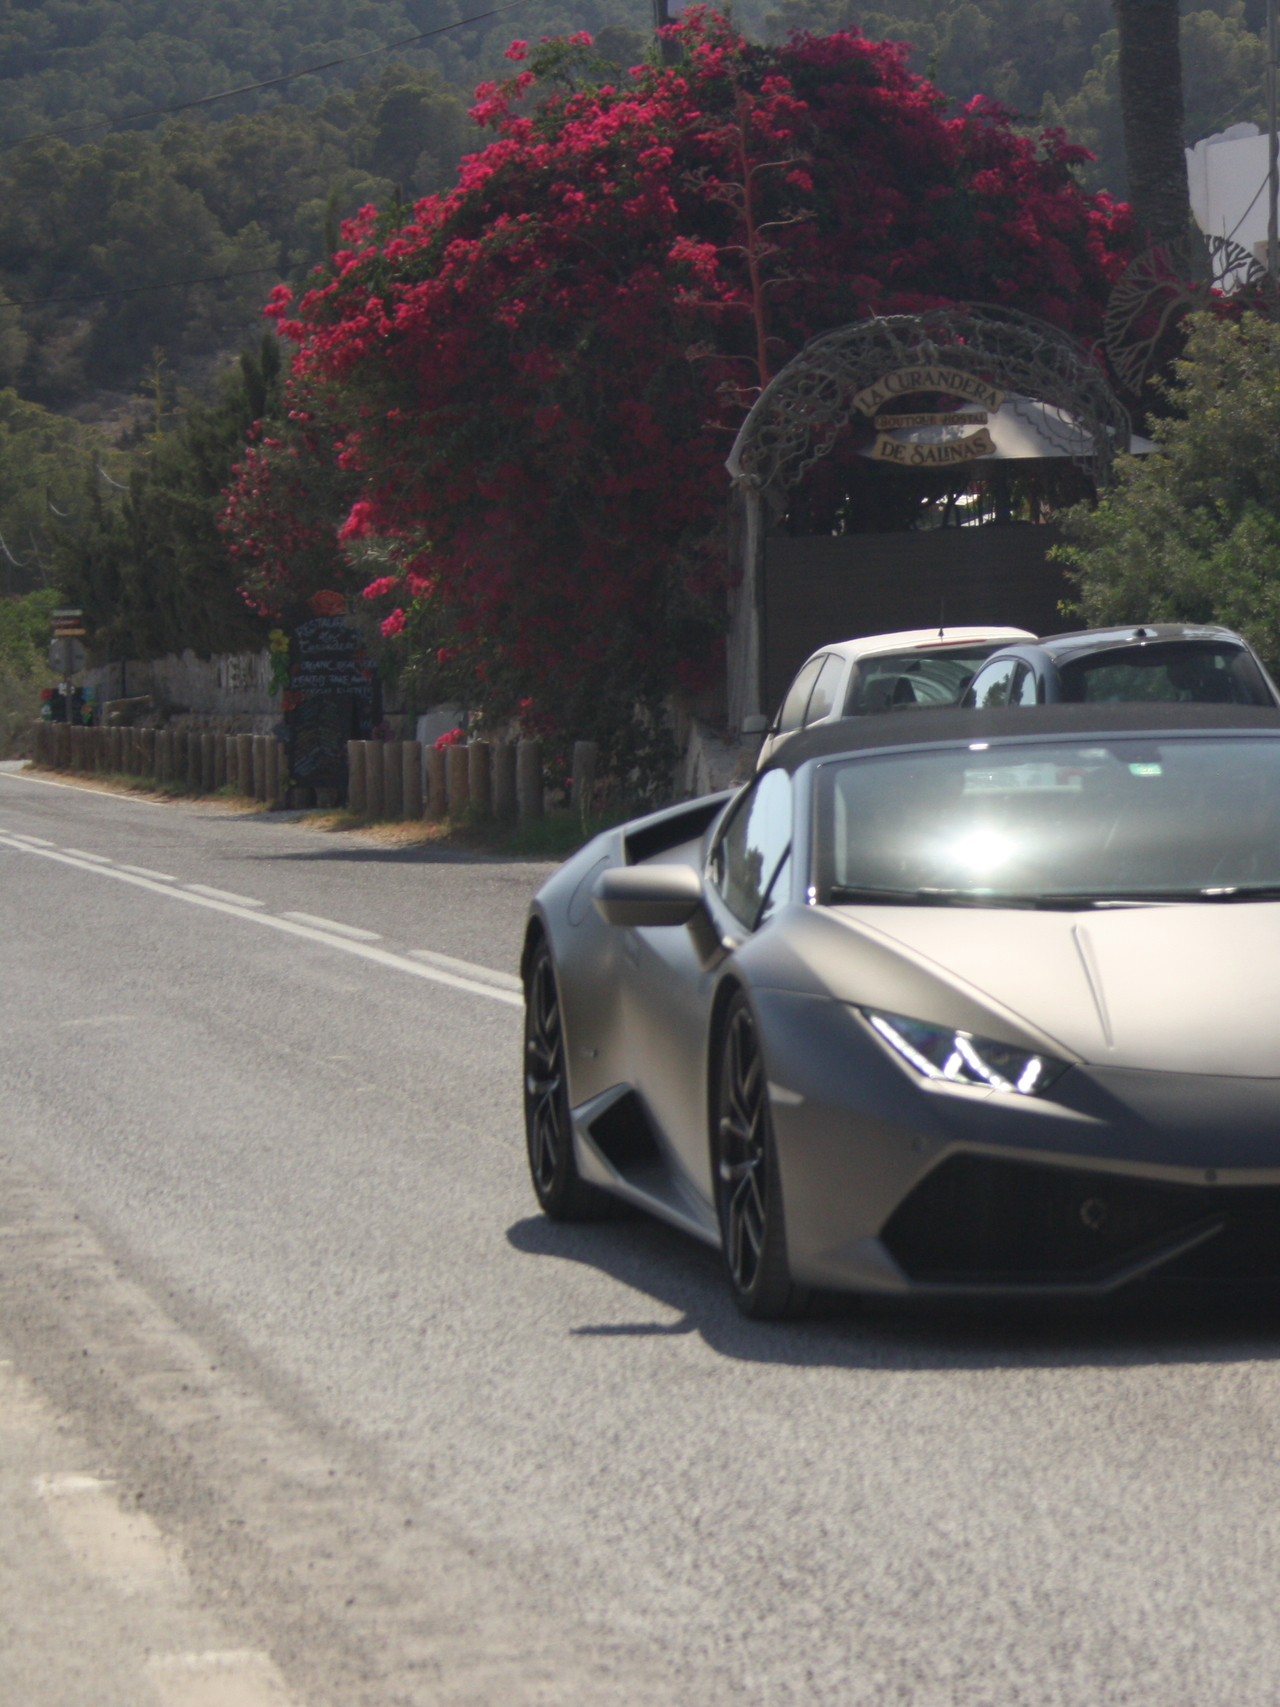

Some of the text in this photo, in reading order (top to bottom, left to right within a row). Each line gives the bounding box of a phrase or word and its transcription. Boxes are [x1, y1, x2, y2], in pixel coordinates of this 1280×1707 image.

[859, 390, 885, 410] LA
[878, 414, 986, 426] BOUTIQUE HOSTAL
[881, 441, 906, 461] DE
